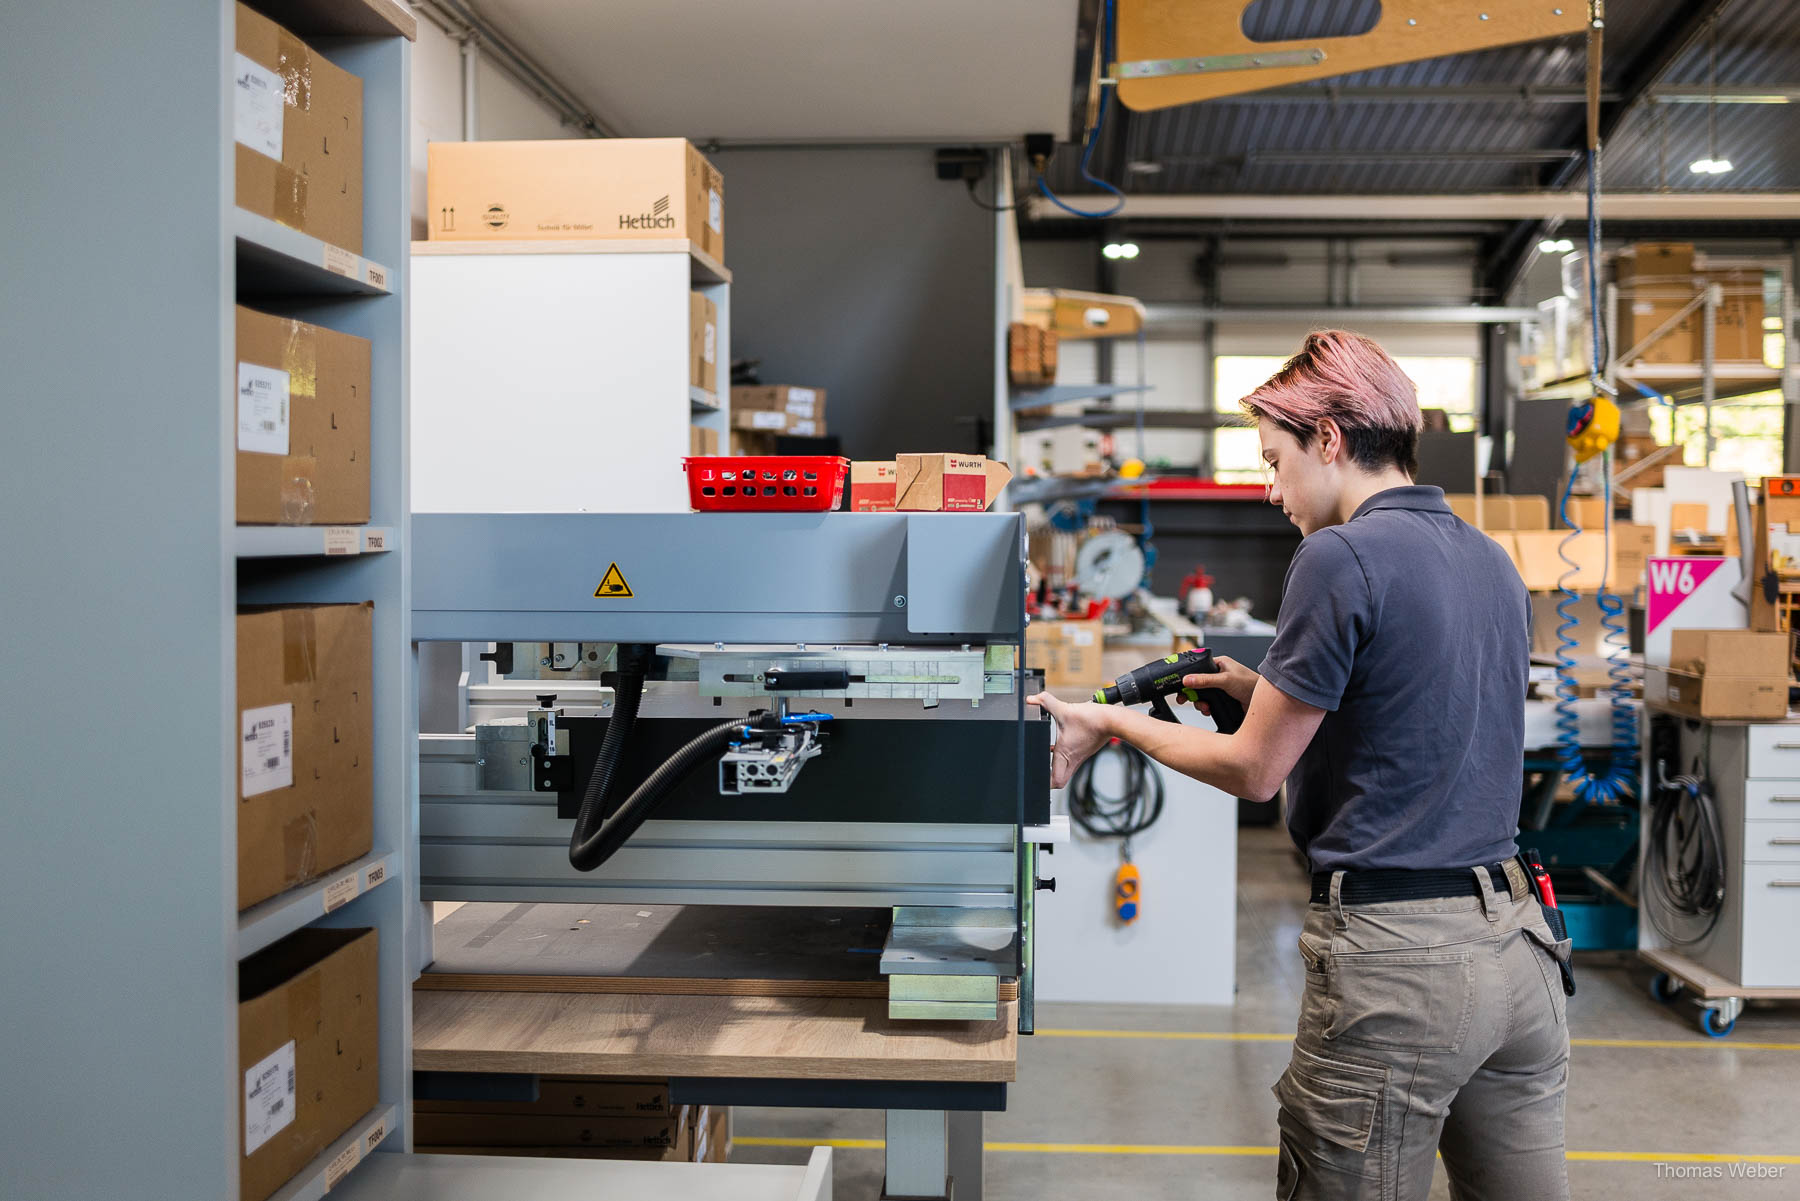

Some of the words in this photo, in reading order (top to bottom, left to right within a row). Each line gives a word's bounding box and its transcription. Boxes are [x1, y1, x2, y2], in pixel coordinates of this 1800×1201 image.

[619, 213, 675, 230] Hettich
[368, 269, 384, 286] TF001
[368, 536, 383, 548] TF002
[1651, 561, 1695, 595] W6
[368, 867, 384, 885] TF003
[368, 1126, 384, 1147] TF004
